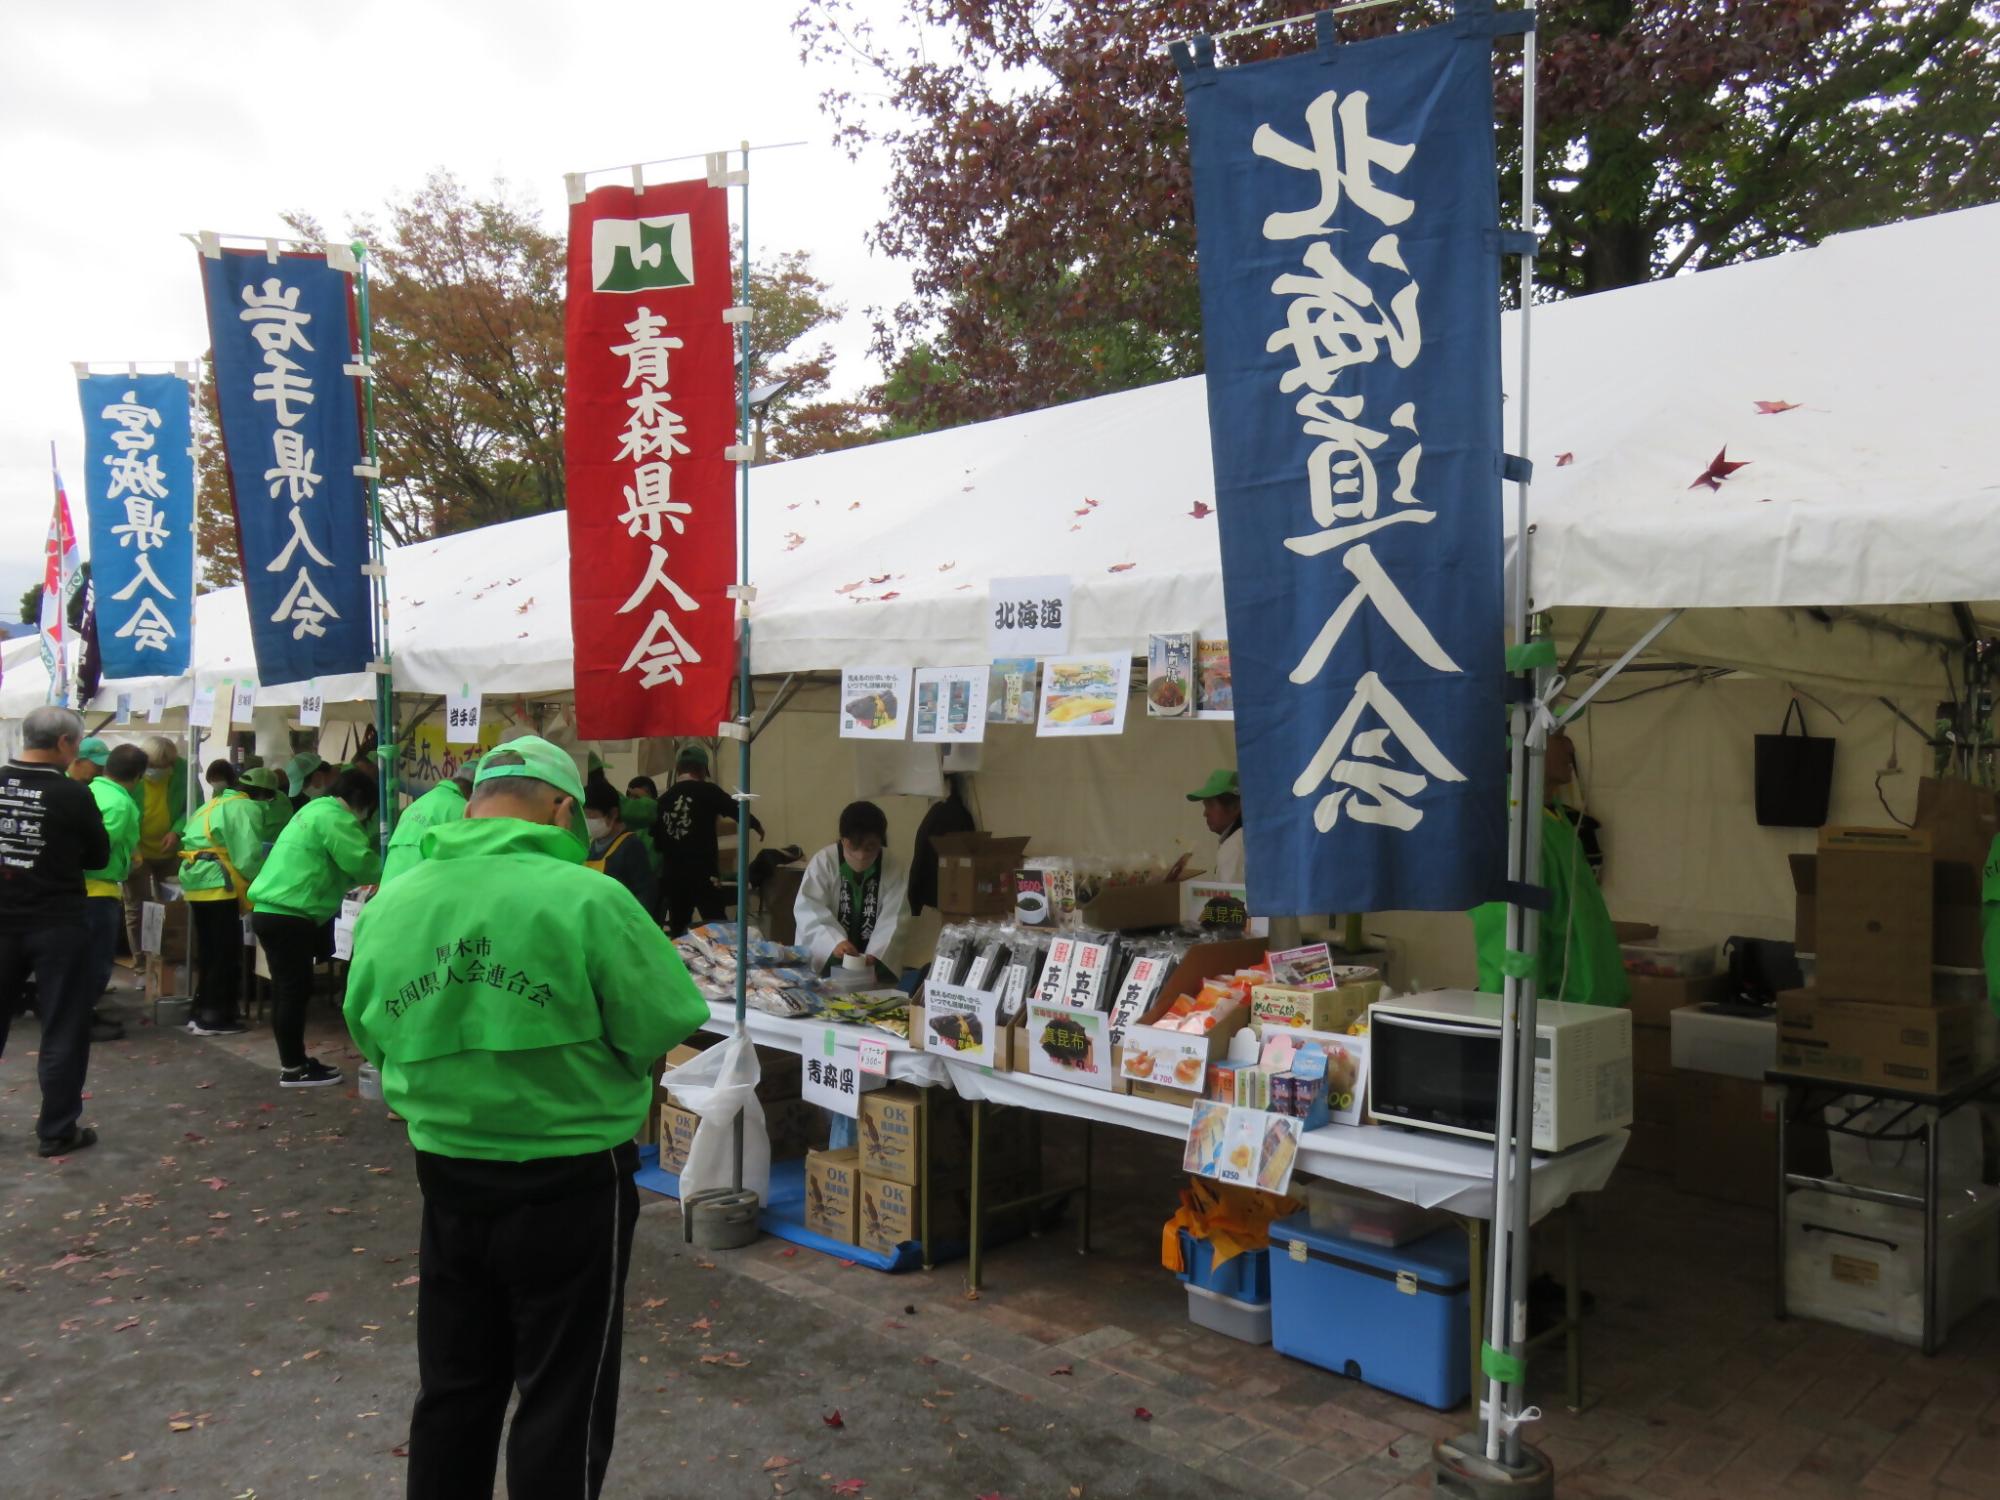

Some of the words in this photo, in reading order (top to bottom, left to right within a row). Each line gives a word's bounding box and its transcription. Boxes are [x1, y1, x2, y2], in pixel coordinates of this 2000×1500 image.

[609, 306, 701, 689] 青森県人会
[995, 599, 1063, 630] 北海道
[450, 706, 478, 728] 岩手県
[436, 937, 492, 966] 厚木市
[384, 959, 553, 1022] 全国県人会連合会
[1043, 1026, 1085, 1050] 真昆布
[807, 1058, 855, 1095] 青森県
[884, 1105, 907, 1121] OK
[827, 1167, 847, 1184] OK
[883, 1185, 904, 1202] OK
